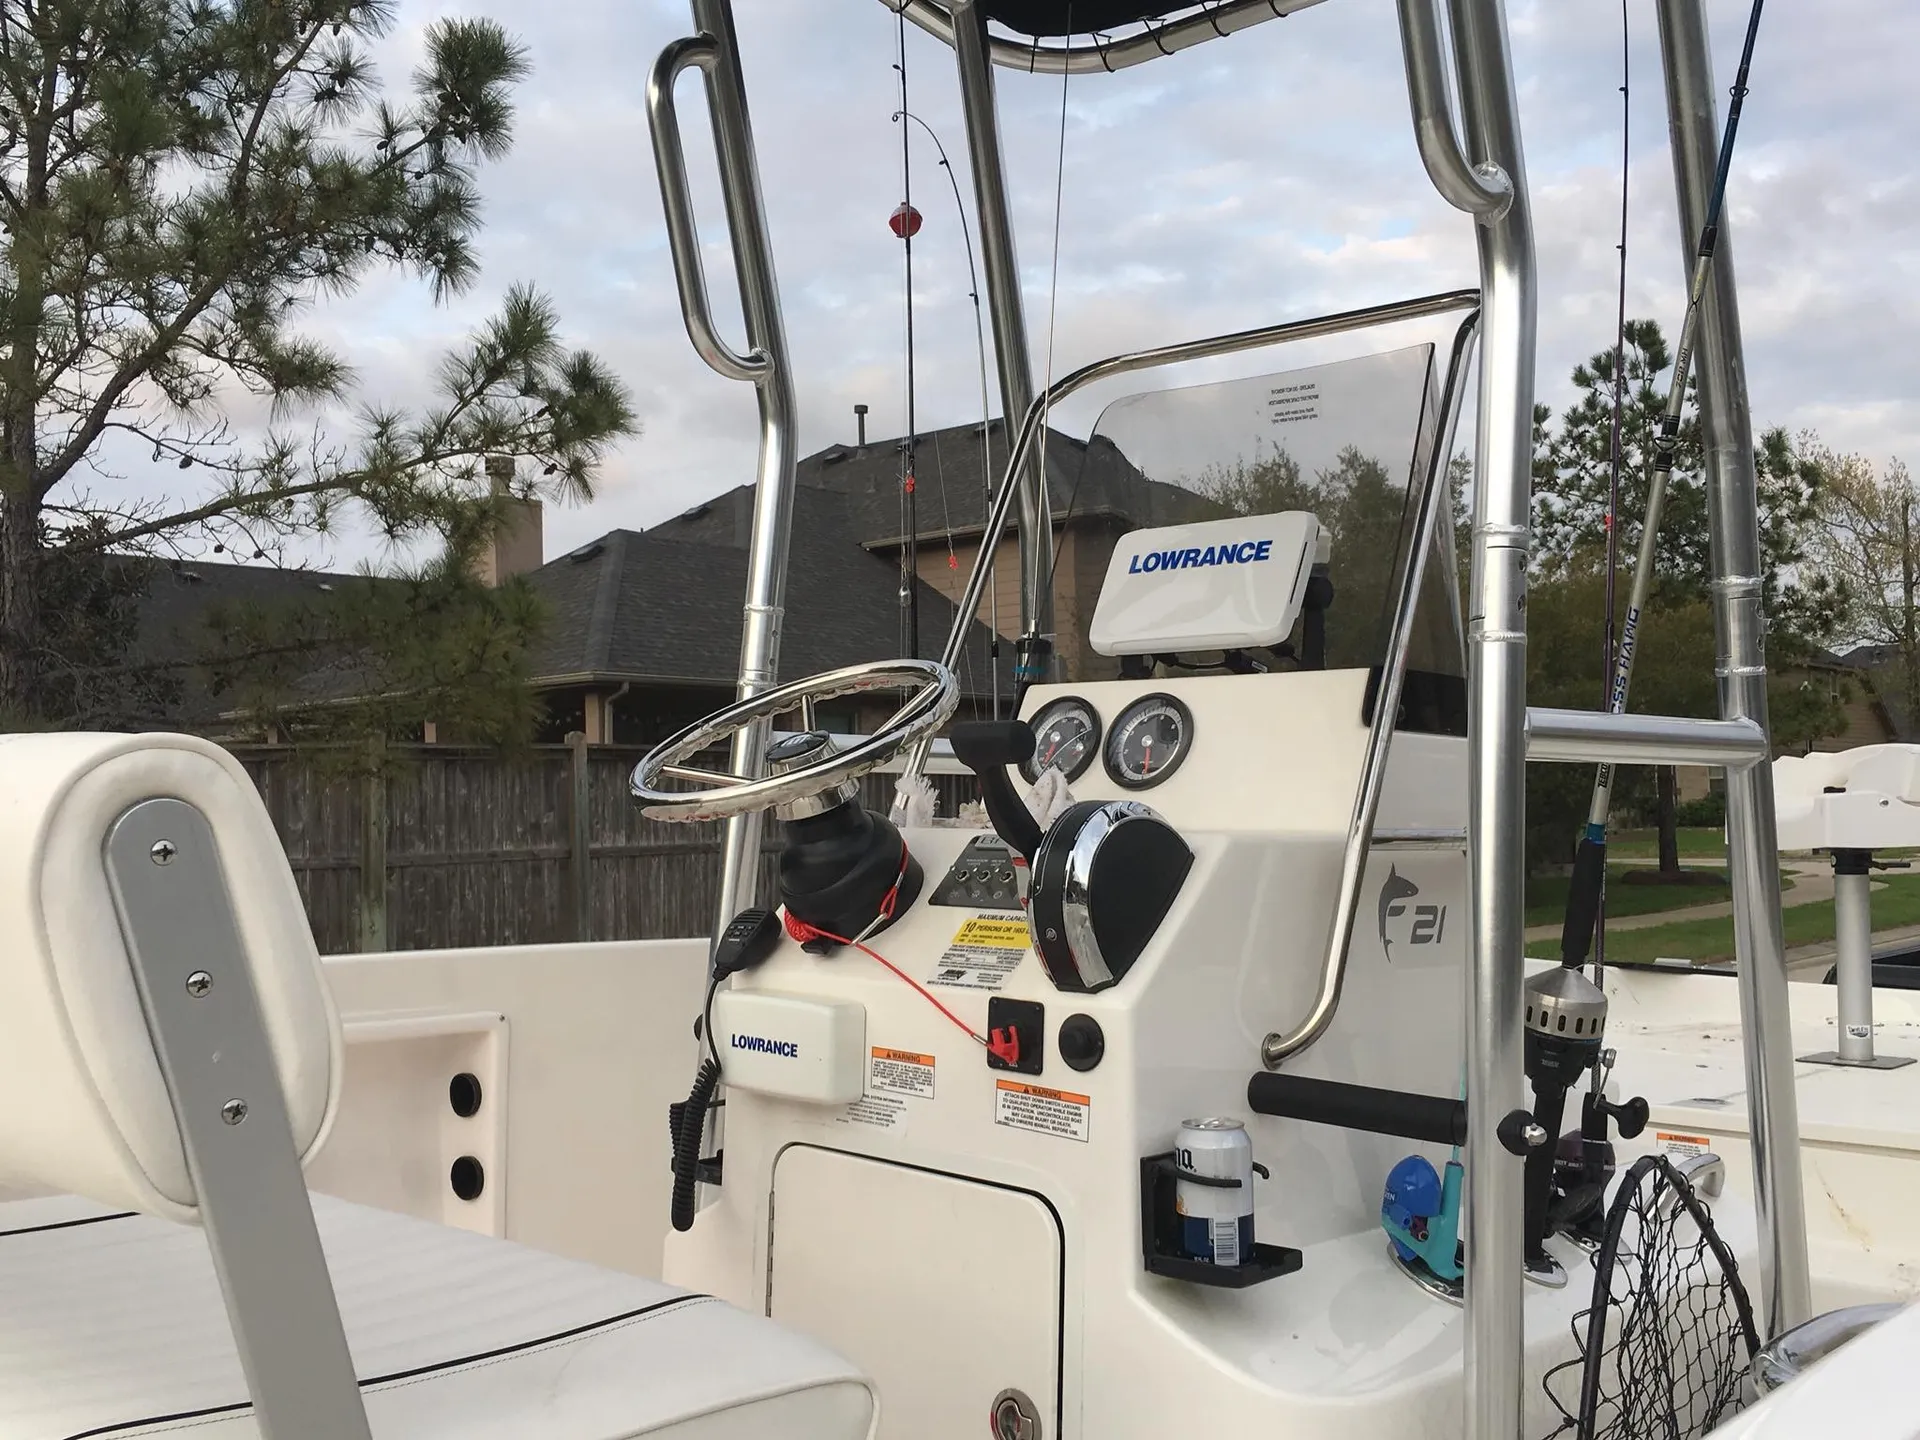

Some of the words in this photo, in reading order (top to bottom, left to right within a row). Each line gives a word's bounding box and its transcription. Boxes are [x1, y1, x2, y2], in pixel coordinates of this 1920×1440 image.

[1128, 540, 1273, 574] LOWRANCE
[1619, 606, 1641, 670] HAWG
[963, 921, 977, 933] 10
[975, 924, 1003, 933] PERSONS
[731, 1033, 798, 1058] LOWRANCE
[892, 1051, 921, 1063] WARNING
[1031, 1087, 1062, 1100] WARNING
[1009, 1099, 1029, 1107] QUALIFIED
[1030, 1102, 1052, 1111] OPERATOR
[1037, 1110, 1070, 1121] UNCONTROLLED
[1051, 1126, 1068, 1134] BEFORE
